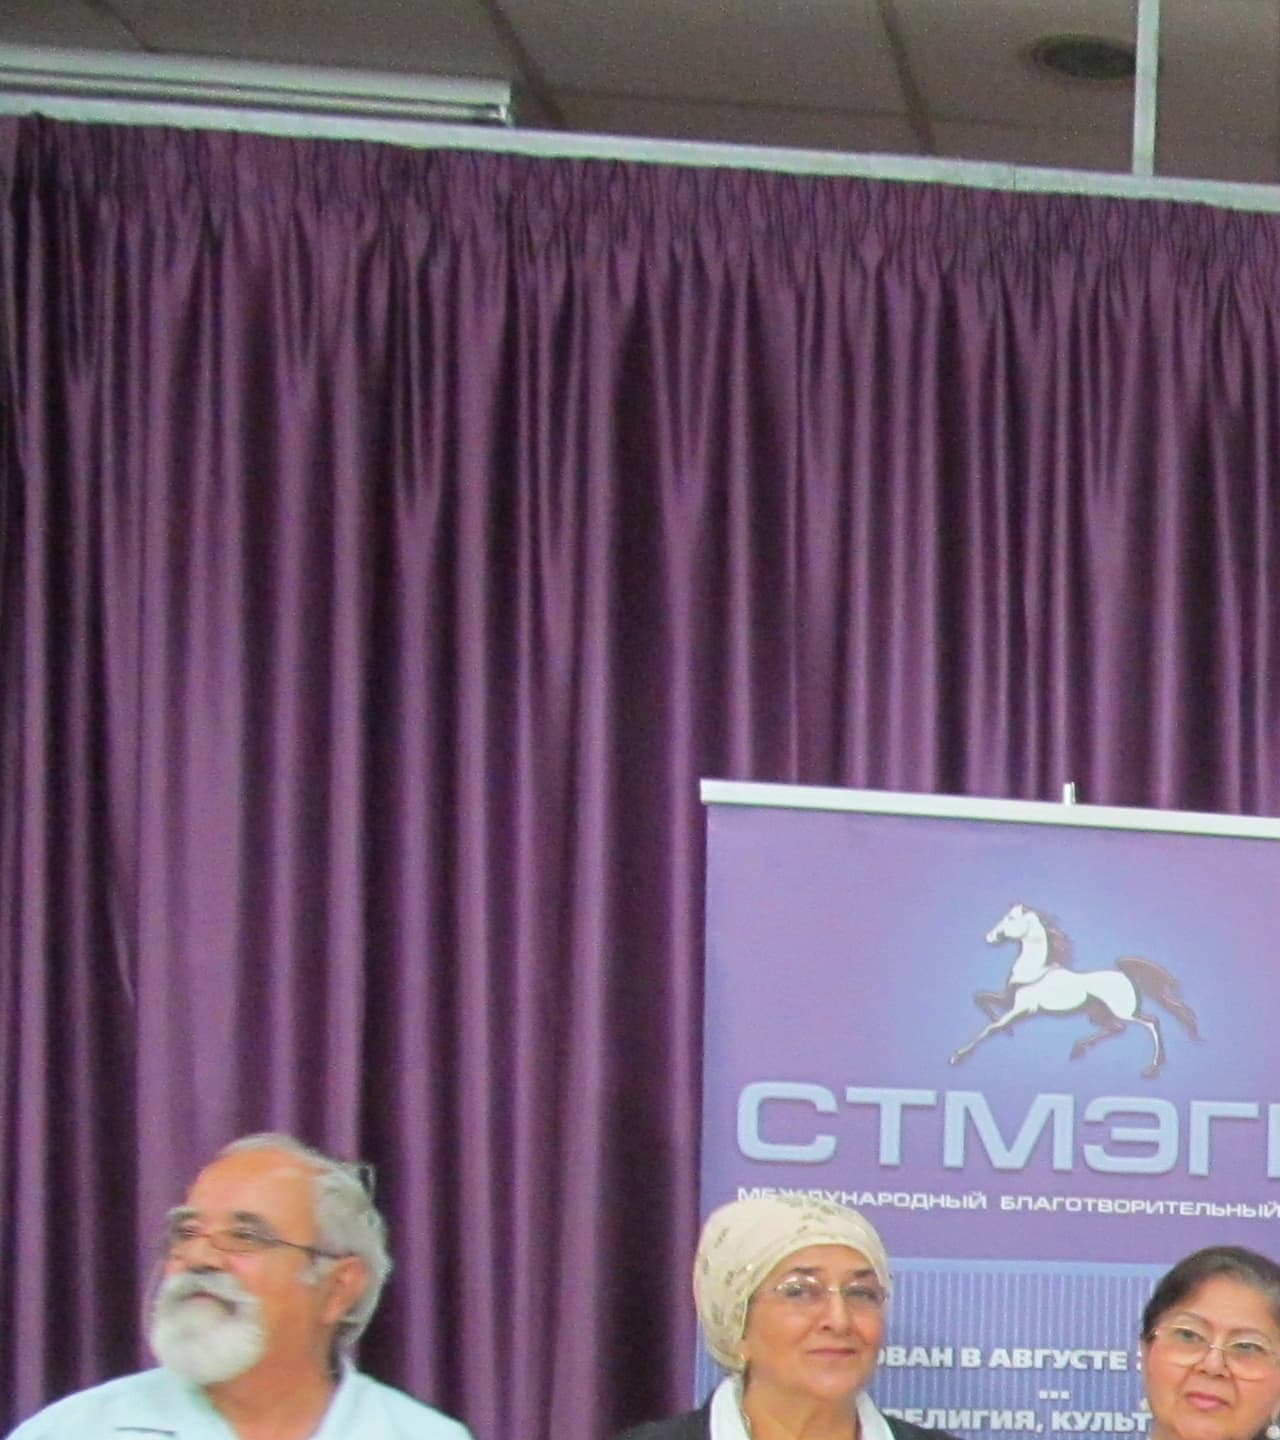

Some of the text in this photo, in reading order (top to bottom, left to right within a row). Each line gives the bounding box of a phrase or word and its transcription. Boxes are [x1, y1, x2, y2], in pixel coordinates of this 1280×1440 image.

[1000, 1195, 1280, 1219] БЛАГОТВОРИТЕЛЬНЫЙ
[960, 1347, 982, 1369] В
[987, 1348, 1128, 1370] АВГУСТЕ
